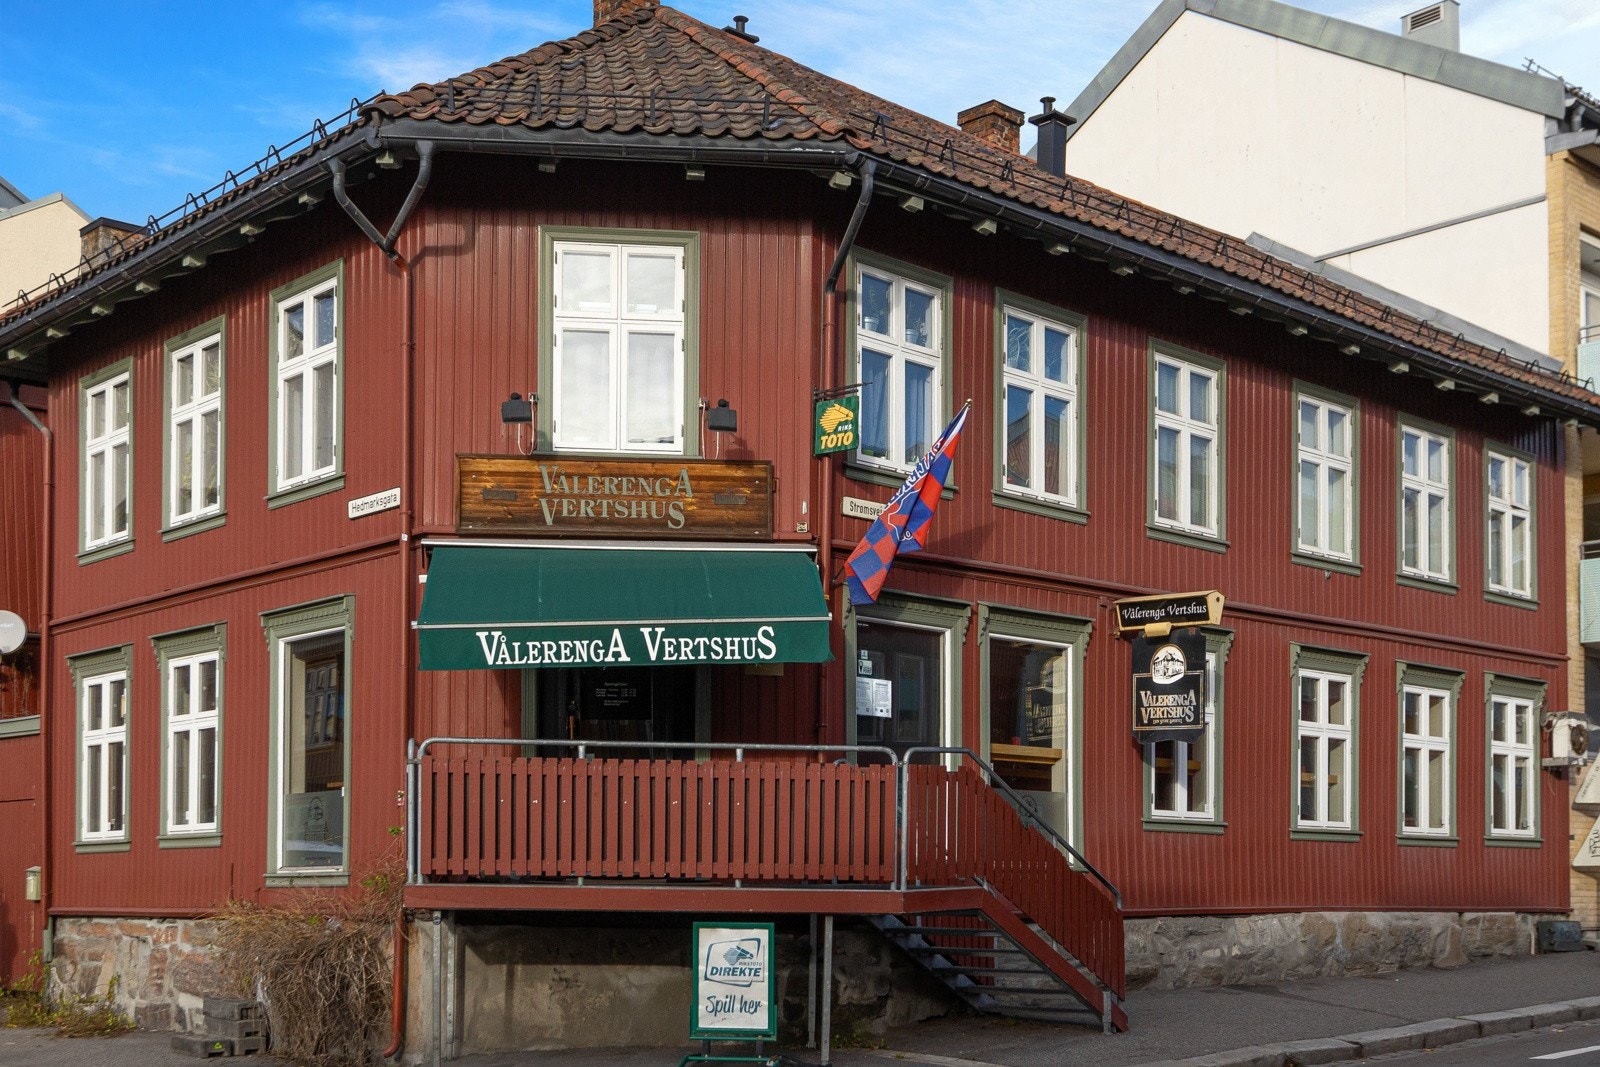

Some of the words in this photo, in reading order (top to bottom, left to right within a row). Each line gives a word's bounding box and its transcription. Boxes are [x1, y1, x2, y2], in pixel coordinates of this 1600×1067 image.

[820, 432, 853, 449] TOTO
[540, 464, 693, 497] VÅLERENGA
[540, 498, 685, 529] VERTSHUS
[1122, 608, 1165, 620] Vålerenga
[1167, 602, 1207, 615] Vertshus
[476, 628, 631, 665] VÅLERENGA
[640, 626, 777, 661] VERTSHUS
[1140, 706, 1194, 724] VERTSHUS
[710, 967, 761, 977] DIREKTE
[705, 995, 736, 1017] Spill
[739, 995, 762, 1014] her
